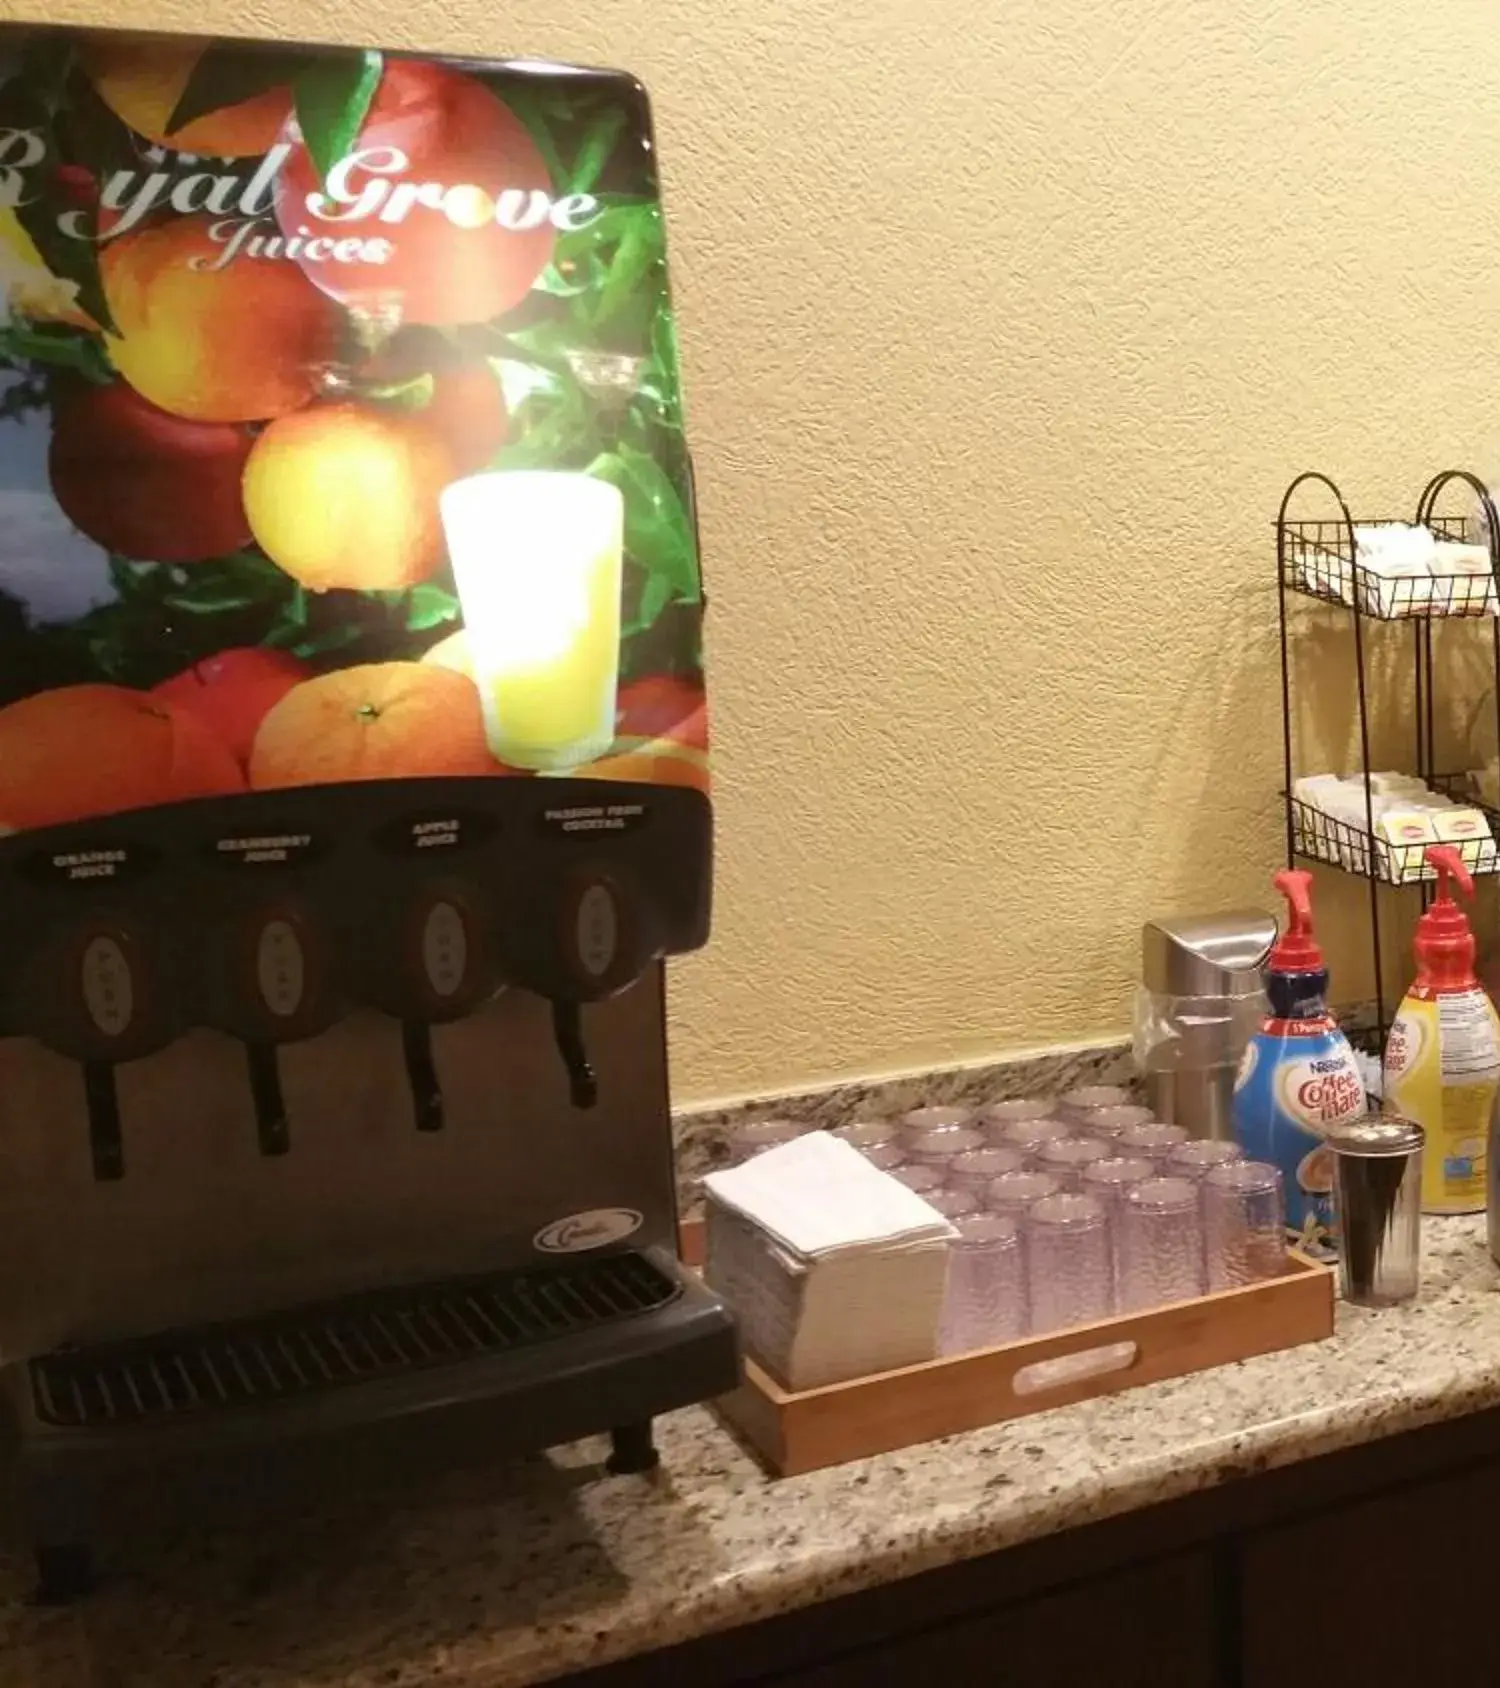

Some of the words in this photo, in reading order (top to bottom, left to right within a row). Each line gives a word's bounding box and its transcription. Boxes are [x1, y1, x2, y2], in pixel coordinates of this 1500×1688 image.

[305, 146, 607, 231] Grove
[189, 216, 397, 272] Juices
[412, 819, 460, 836] APPLE
[52, 849, 127, 867] ORANGE
[68, 863, 116, 880] JUICE
